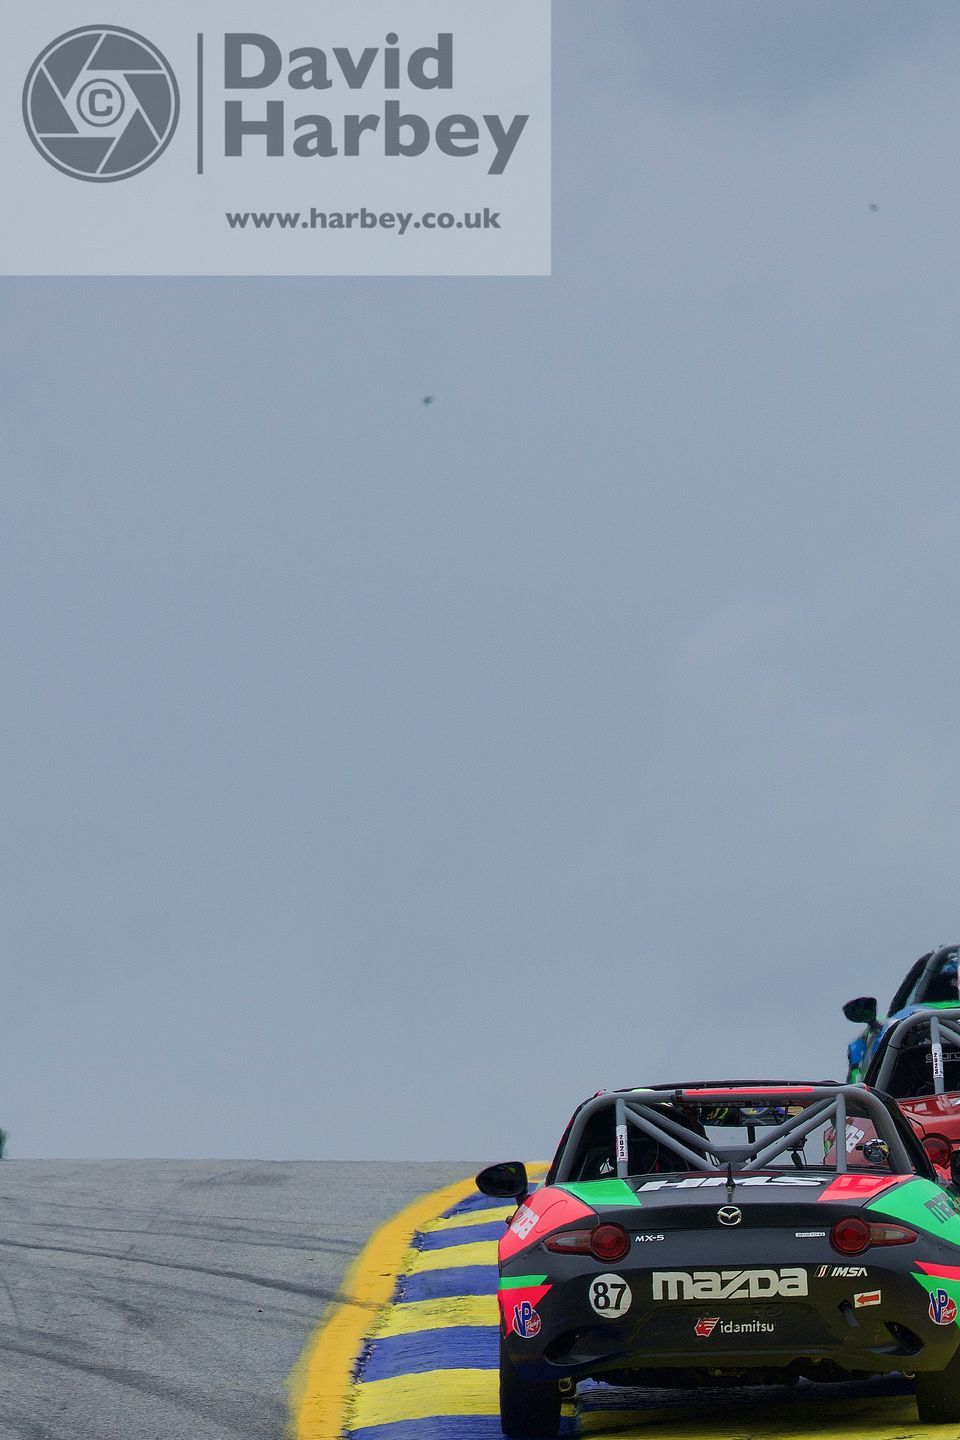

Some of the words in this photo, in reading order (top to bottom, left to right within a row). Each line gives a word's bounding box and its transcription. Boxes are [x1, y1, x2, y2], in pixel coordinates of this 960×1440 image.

[635, 1233, 665, 1242] MX-5
[831, 1266, 868, 1277] IMSA
[593, 1281, 627, 1311] 87
[720, 1318, 774, 1333] idemitsu
